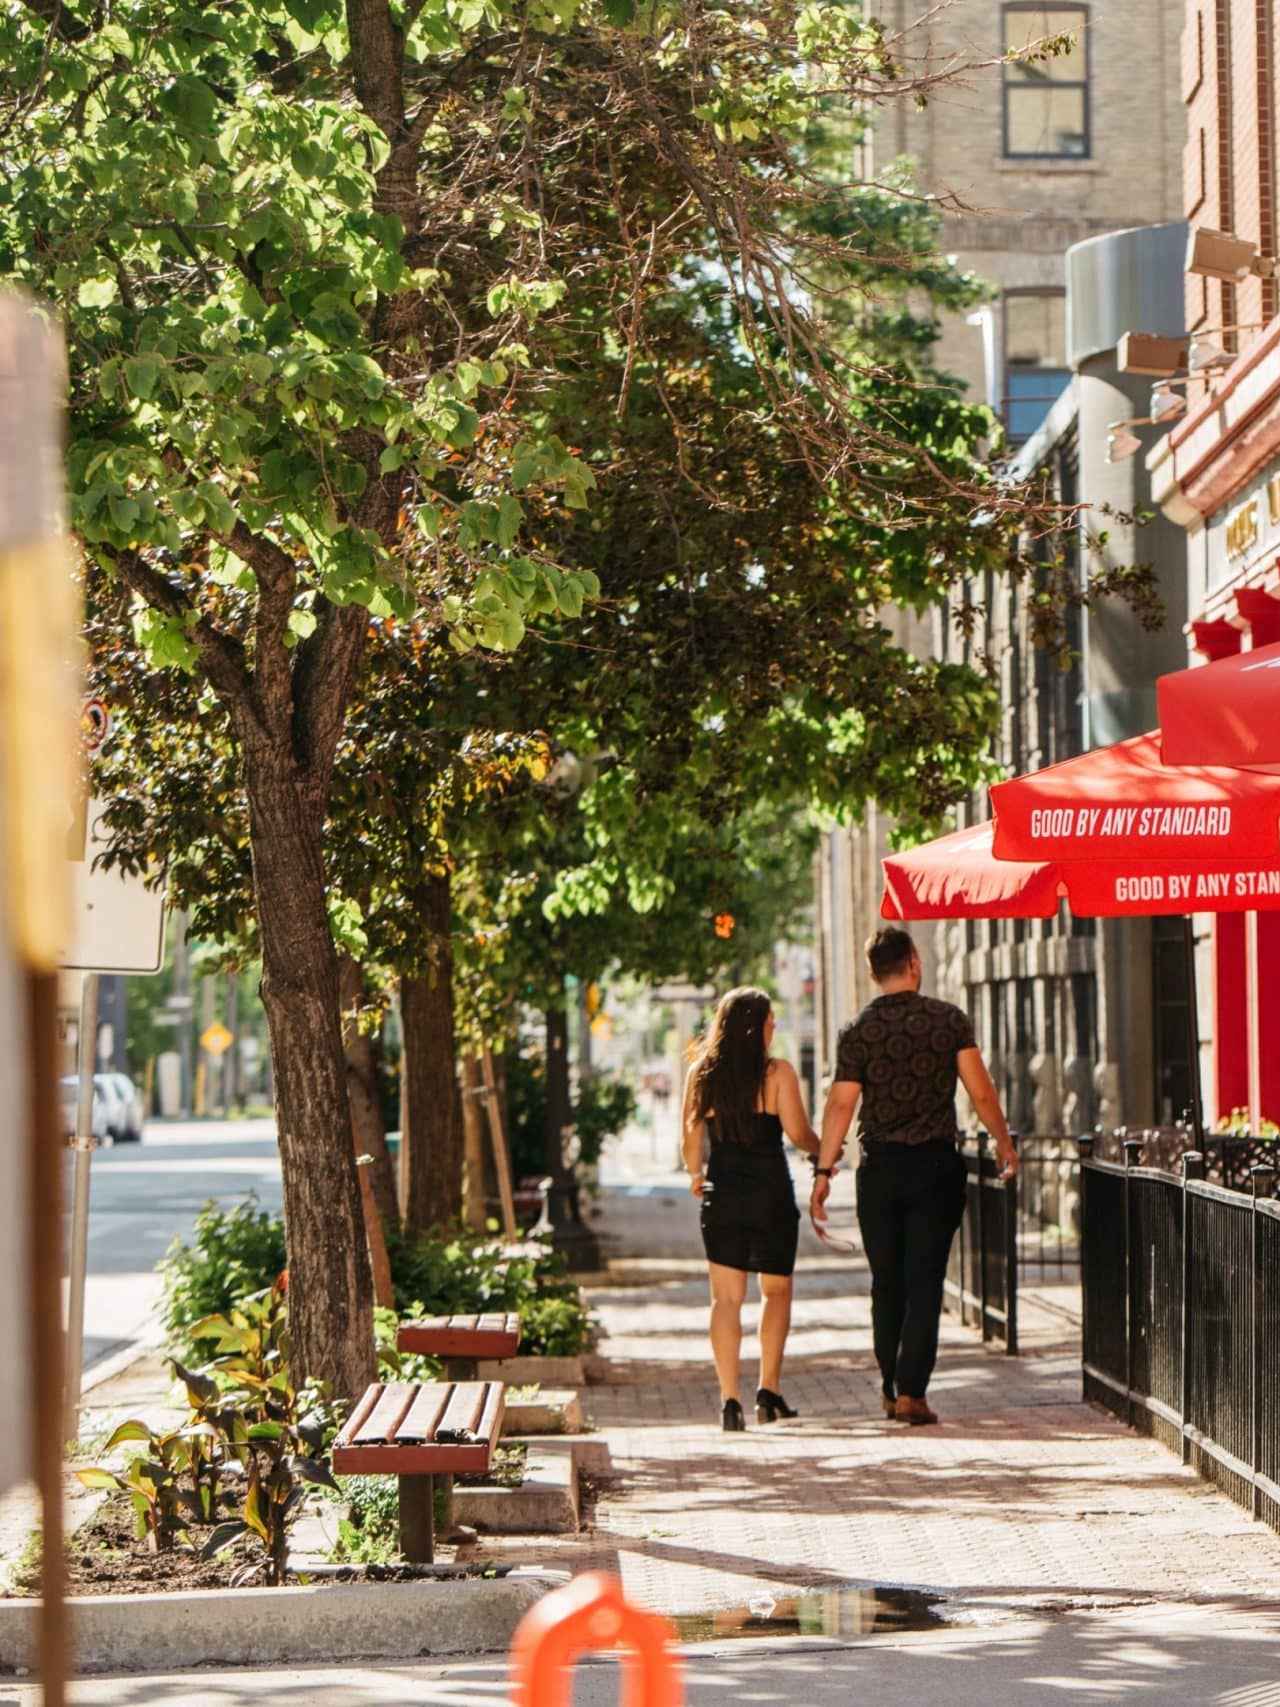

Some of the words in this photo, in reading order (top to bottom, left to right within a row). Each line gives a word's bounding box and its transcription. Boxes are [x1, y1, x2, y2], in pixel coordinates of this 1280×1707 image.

[1031, 809, 1074, 838] GOOD
[1075, 808, 1101, 837] BY
[1100, 807, 1138, 837] ANY
[1138, 806, 1231, 836] STANDARD
[1115, 876, 1164, 901] GOOD
[1168, 875, 1191, 898] BY
[1196, 873, 1230, 897] ANY
